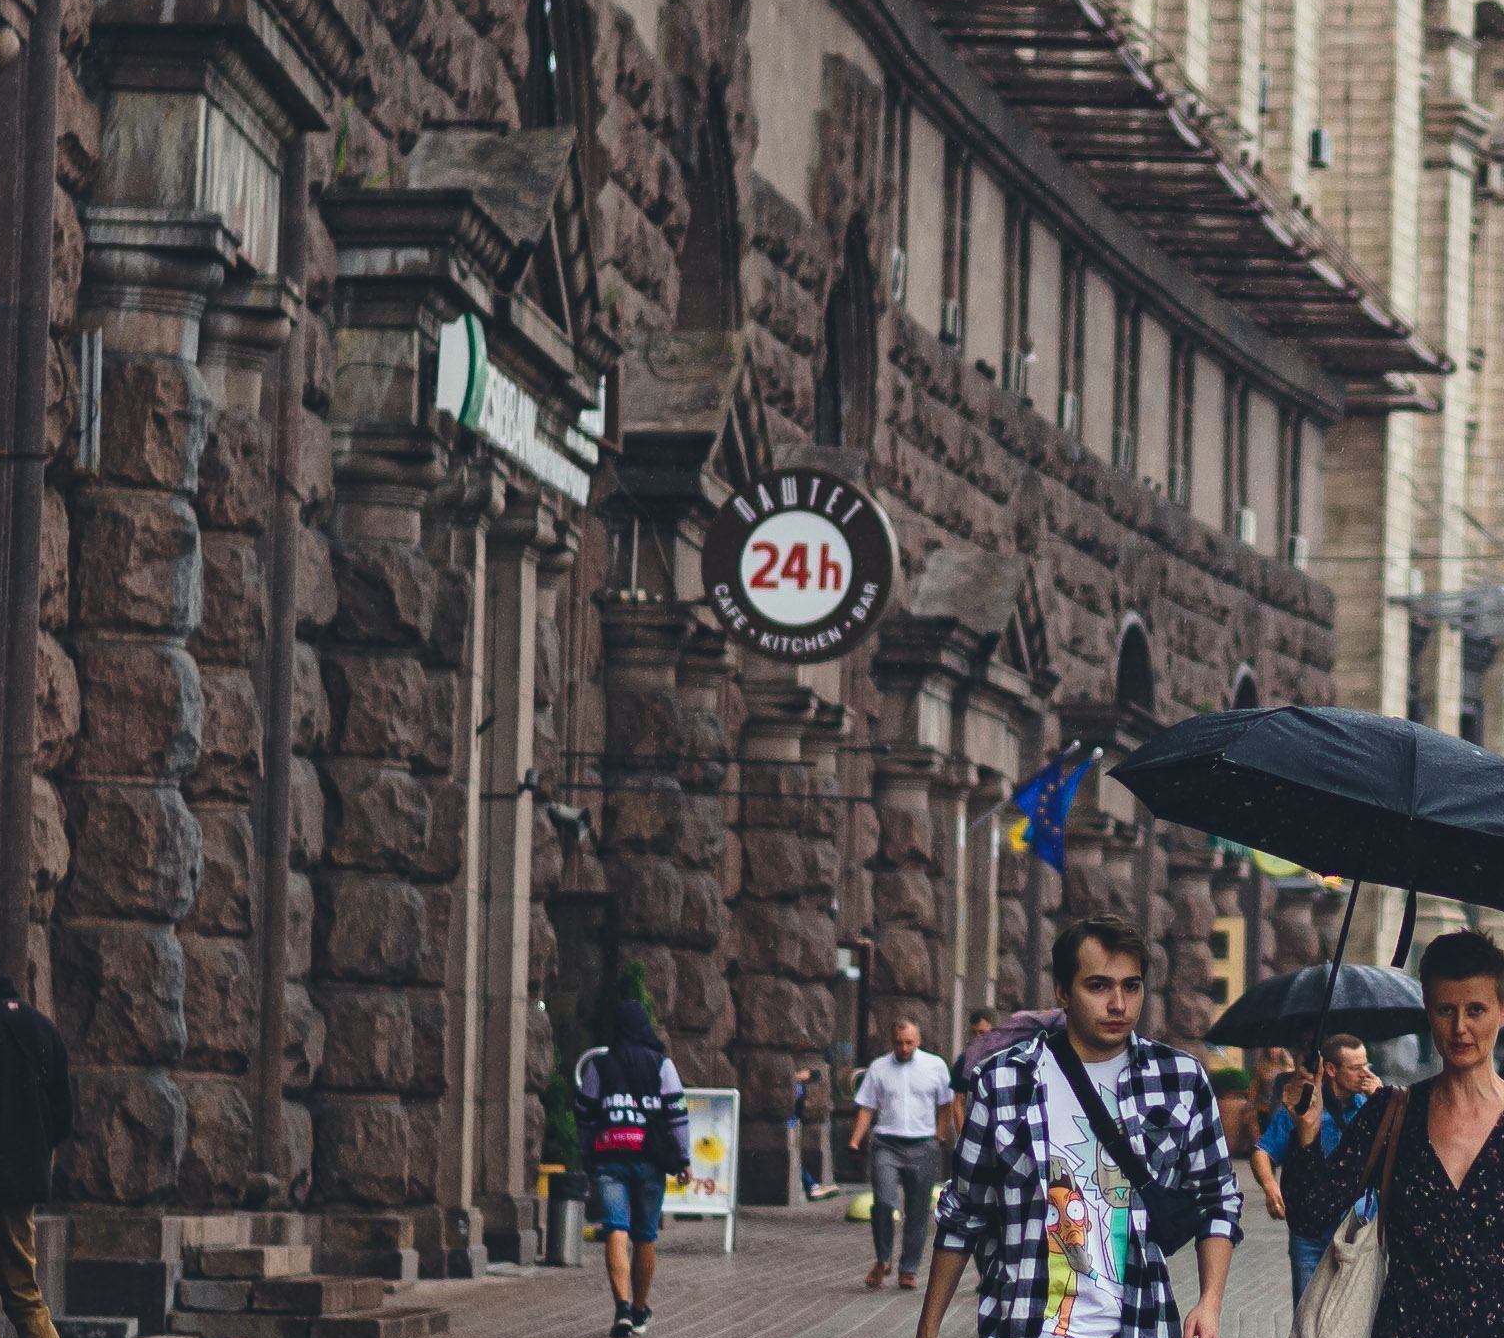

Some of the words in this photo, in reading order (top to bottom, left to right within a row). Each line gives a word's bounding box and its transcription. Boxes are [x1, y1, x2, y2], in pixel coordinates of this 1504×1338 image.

[734, 474, 864, 525] ПАШТЕТ
[714, 583, 748, 630] CAFE
[760, 626, 842, 653] KITCHEN
[852, 581, 879, 621] BAR
